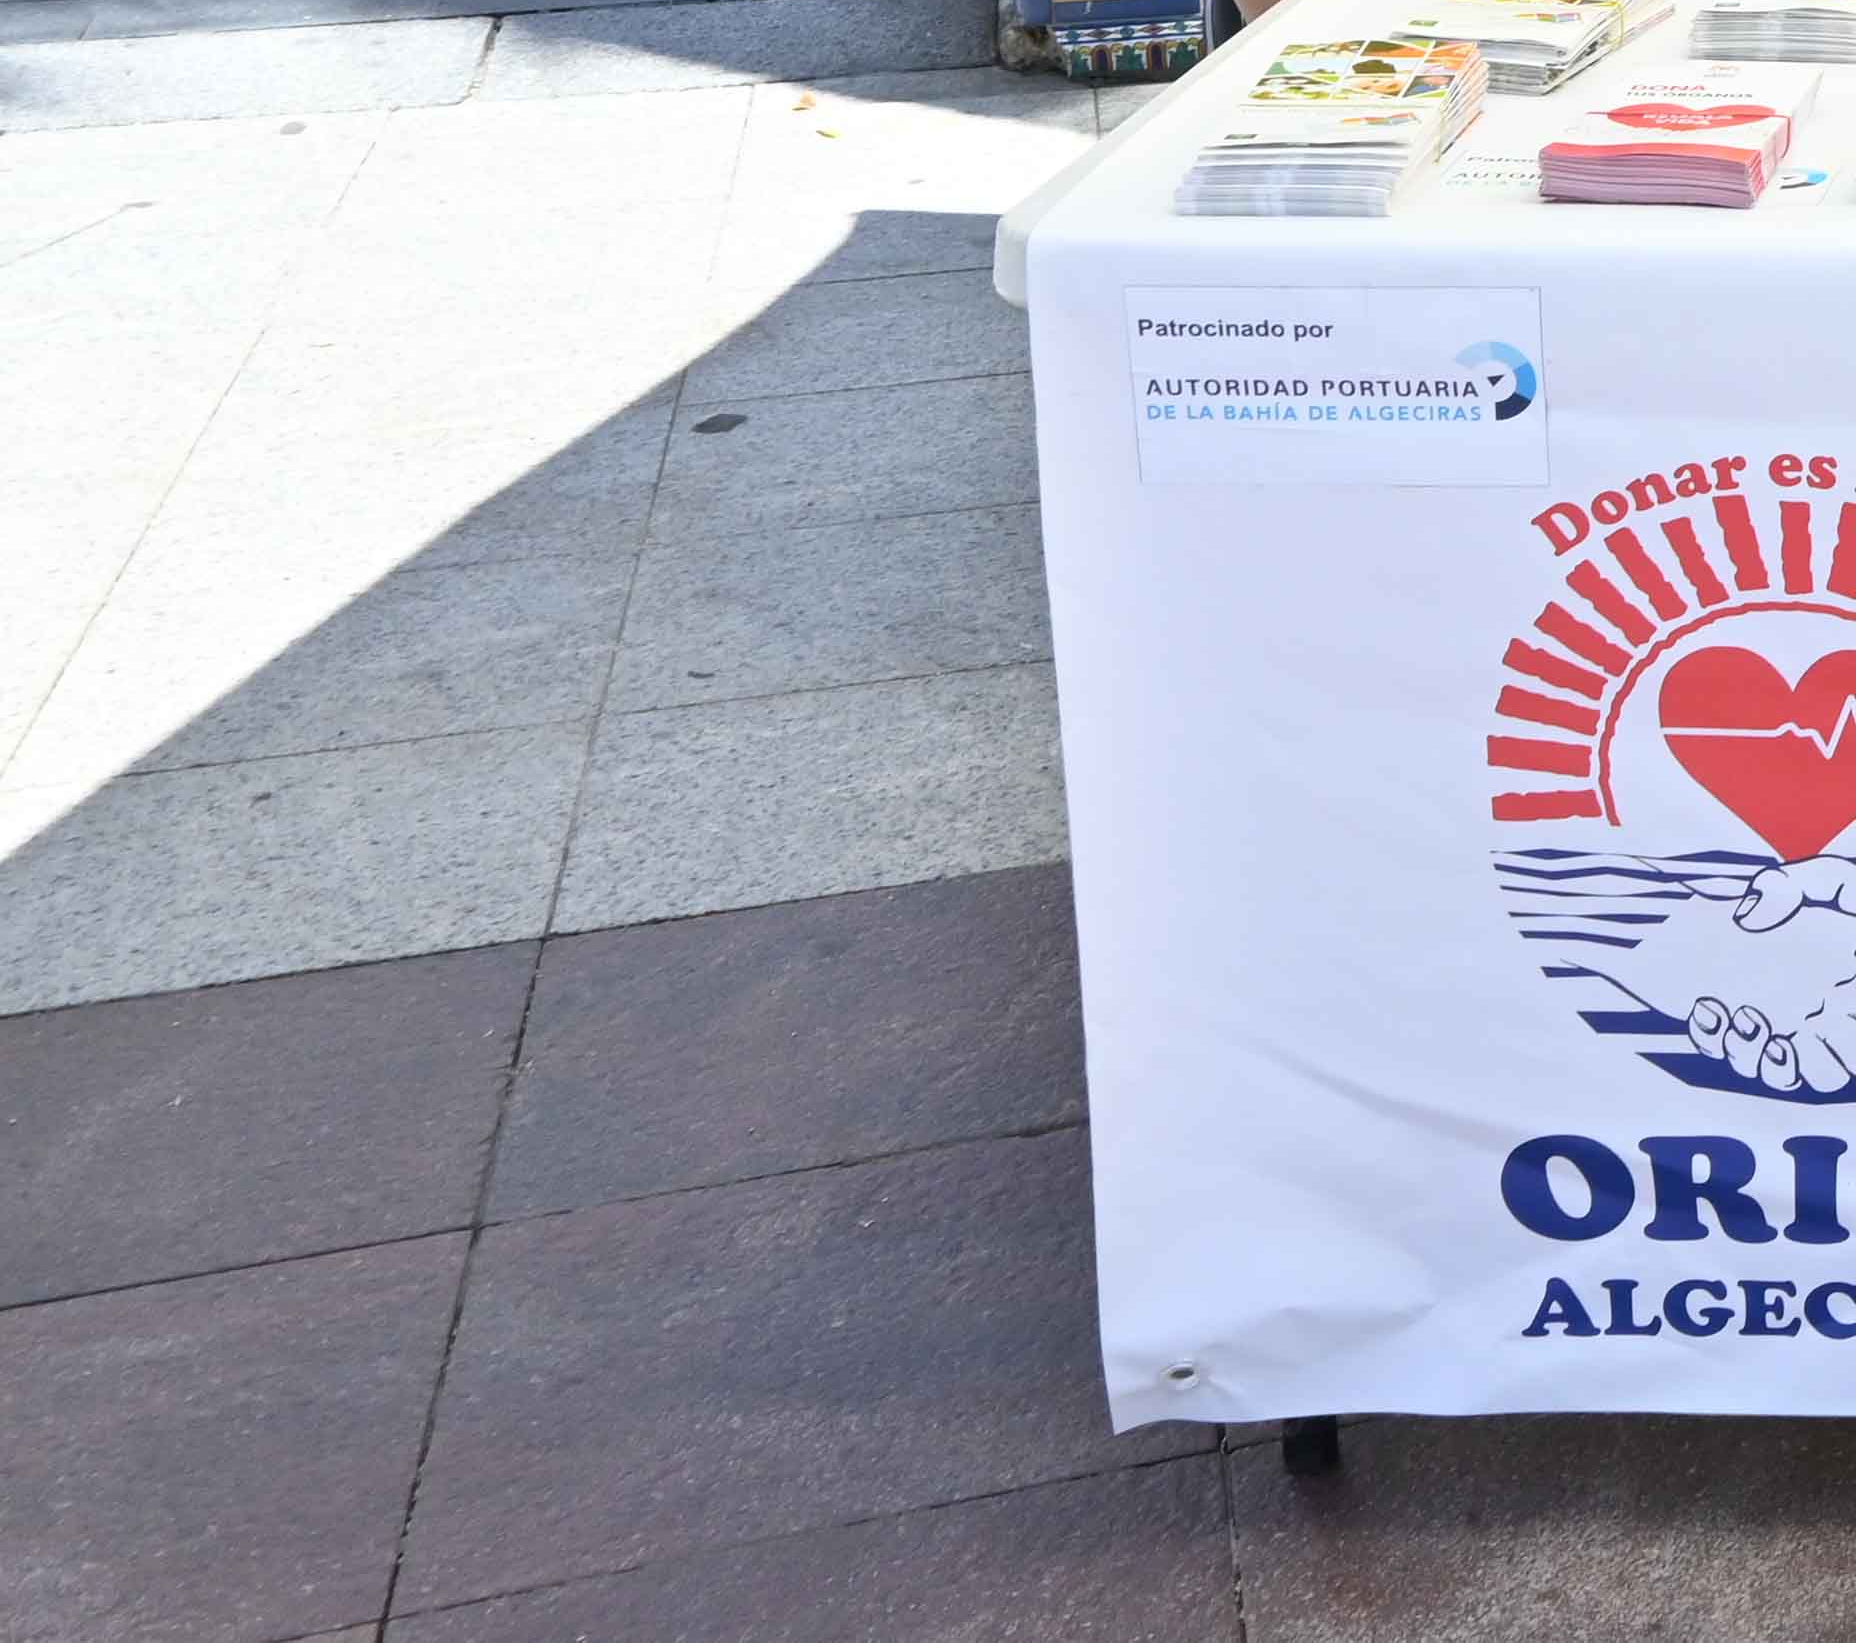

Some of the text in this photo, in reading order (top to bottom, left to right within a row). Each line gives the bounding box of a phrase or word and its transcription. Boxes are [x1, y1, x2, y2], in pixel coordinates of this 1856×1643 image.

[1631, 84, 1706, 92] DONA
[1138, 319, 1334, 342] Patrocinado por
[1146, 378, 1480, 399] AUTORIDAD PORTUARIA
[1147, 401, 1482, 422] DE LA BAHÍA DE ALGECIRAS
[1530, 455, 1747, 556] Donar
[1768, 453, 1838, 489] es
